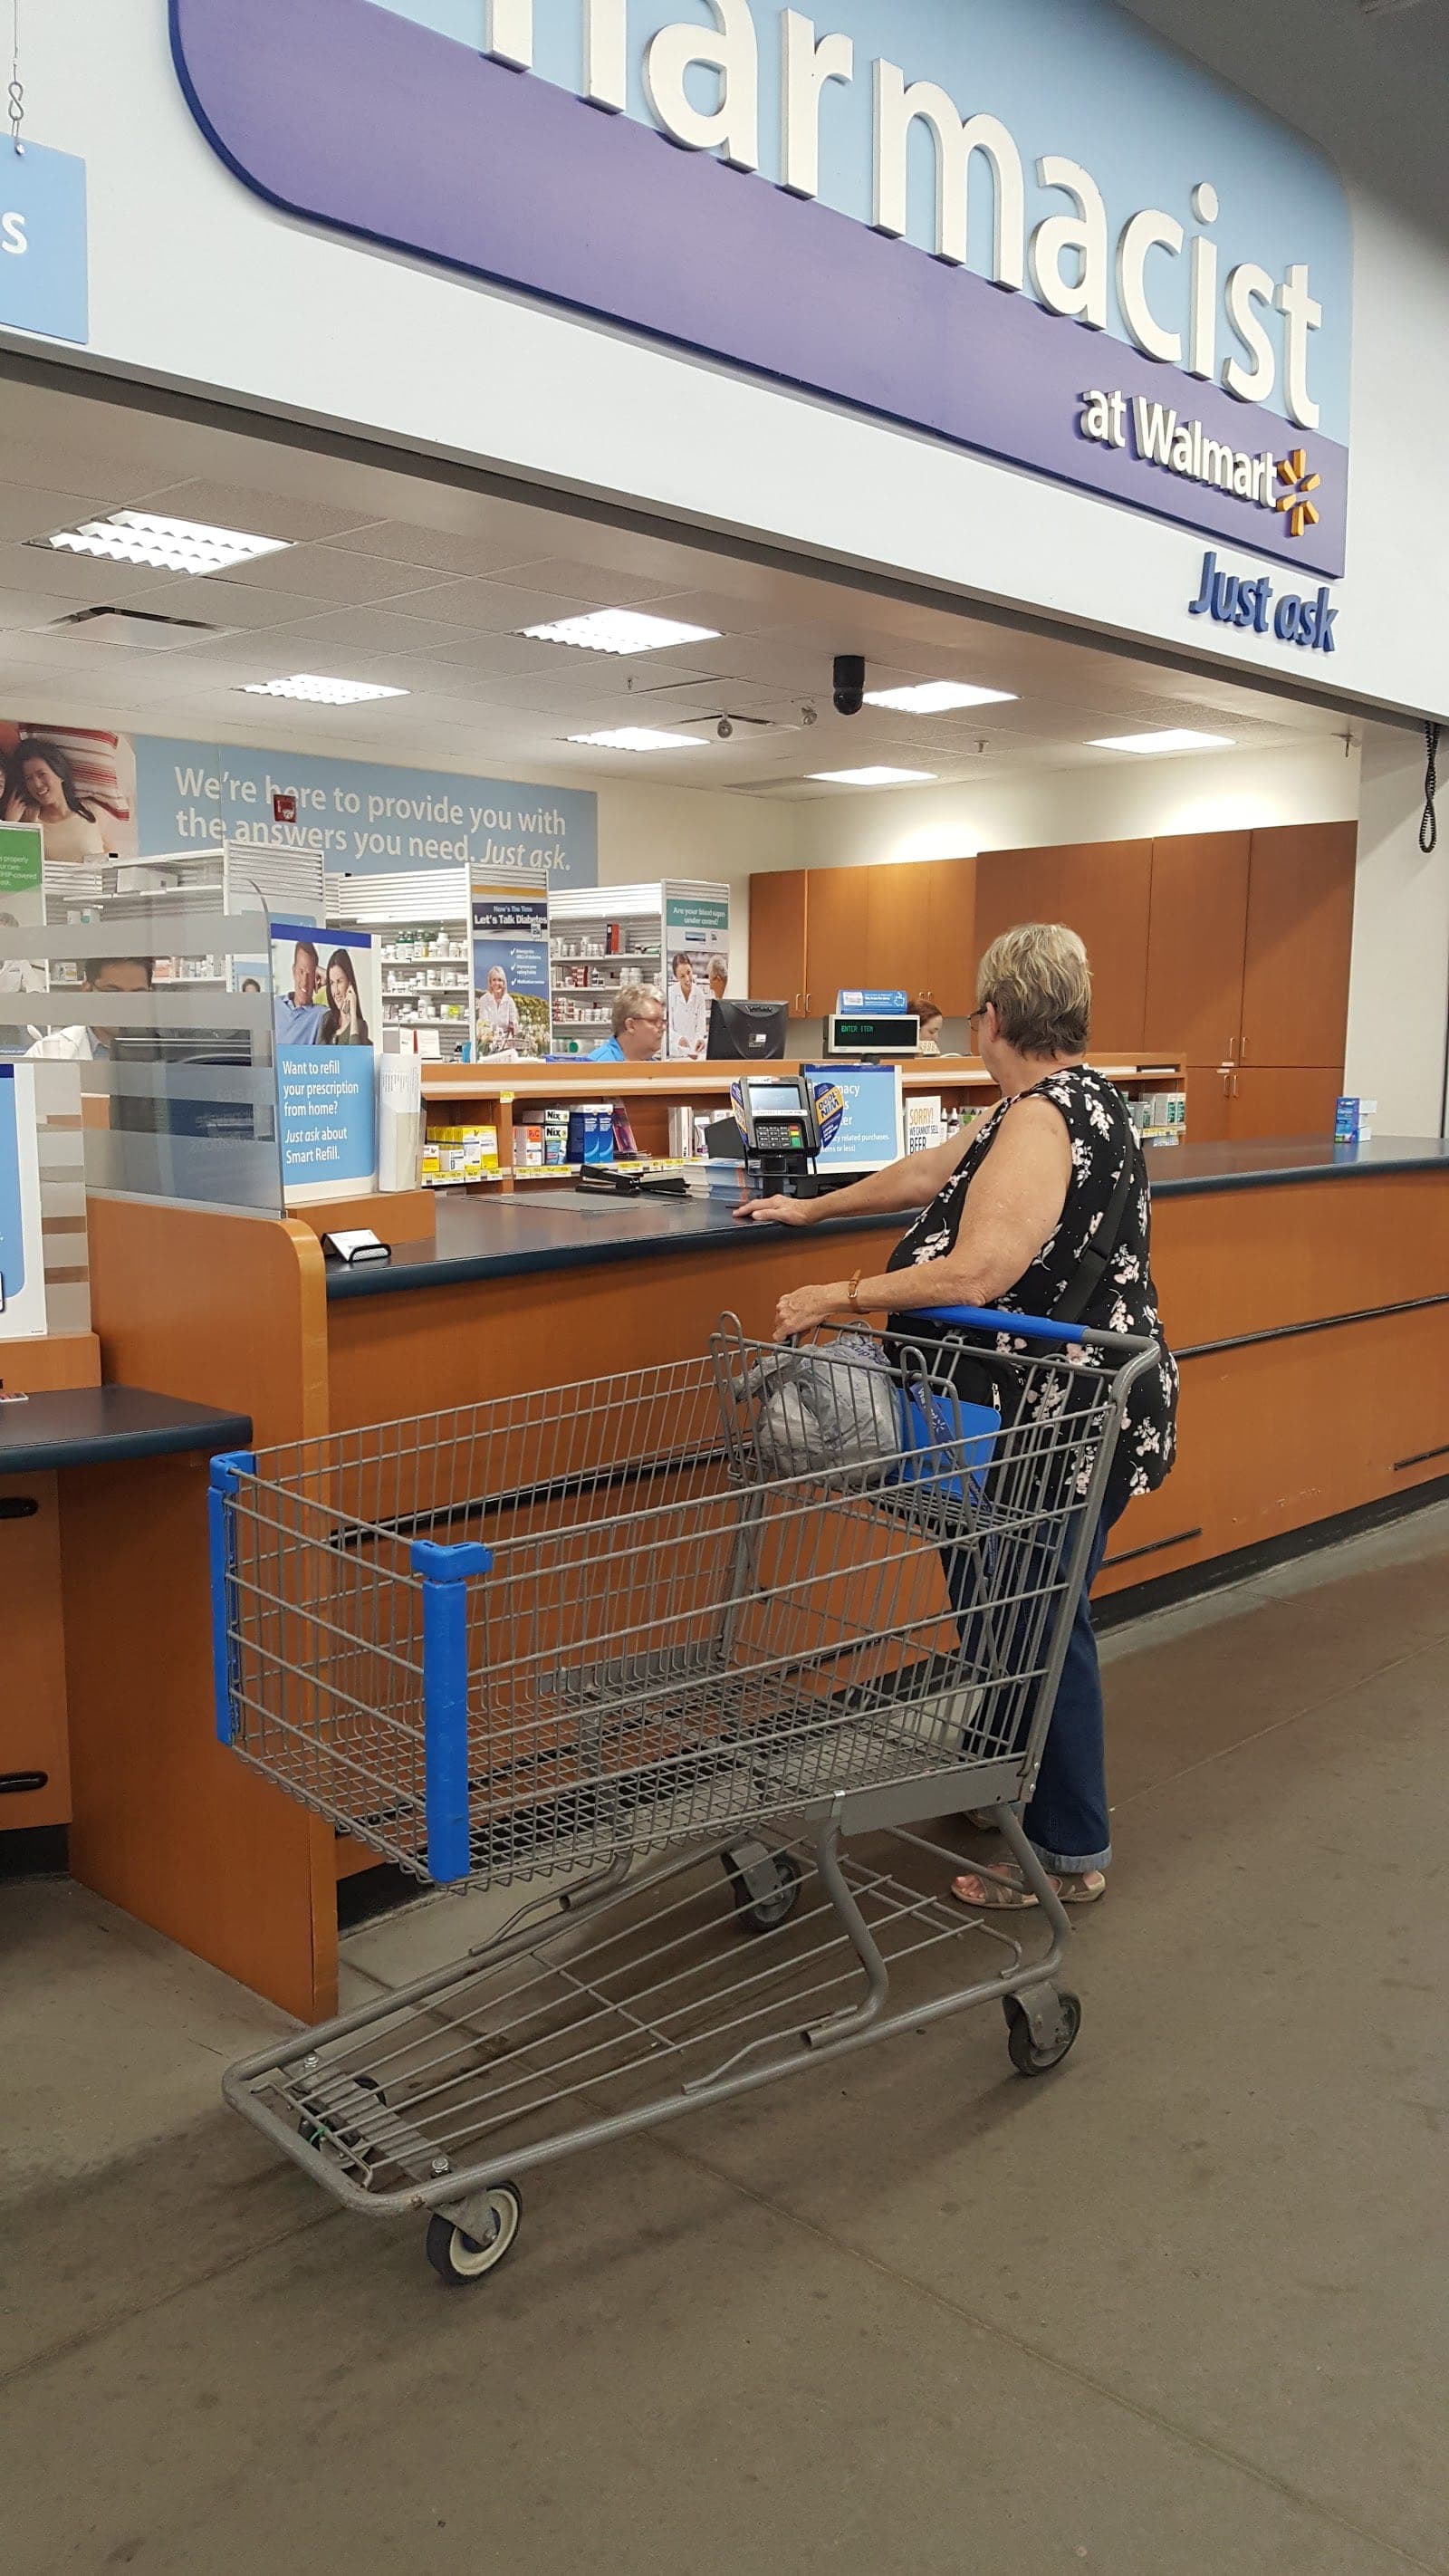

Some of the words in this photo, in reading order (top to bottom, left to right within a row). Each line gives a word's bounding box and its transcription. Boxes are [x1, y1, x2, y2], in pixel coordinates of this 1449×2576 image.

[1080, 389, 1127, 448] at
[1133, 395, 1278, 508] Walmart
[1188, 551, 1272, 632] Just
[1274, 586, 1339, 651] ask
[174, 766, 257, 803] We're
[332, 787, 360, 813] to
[368, 794, 463, 825] provide
[469, 807, 512, 833] you
[518, 808, 566, 836] with
[176, 807, 226, 840] the
[235, 820, 348, 851] answers
[354, 831, 401, 860] you
[408, 834, 475, 862] need.
[480, 839, 525, 867] Just
[530, 844, 571, 870] ask.
[474, 914, 497, 925] Let's
[498, 914, 515, 924] Talk
[283, 1061, 306, 1075] Want
[309, 1063, 318, 1074] to
[320, 1060, 340, 1074] refill
[283, 1083, 305, 1099] your
[307, 1081, 359, 1098] prescription
[284, 1102, 306, 1117] from
[308, 1101, 338, 1116] home?
[547, 1111, 561, 1120] Nix
[909, 1108, 934, 1126] SORRY!
[285, 1129, 302, 1144] Just
[304, 1128, 320, 1141] ask
[321, 1127, 348, 1140] about
[546, 1128, 561, 1138] Nix
[909, 1136, 926, 1153] BEER
[286, 1149, 313, 1164] Smart
[315, 1145, 340, 1162] Refill.
